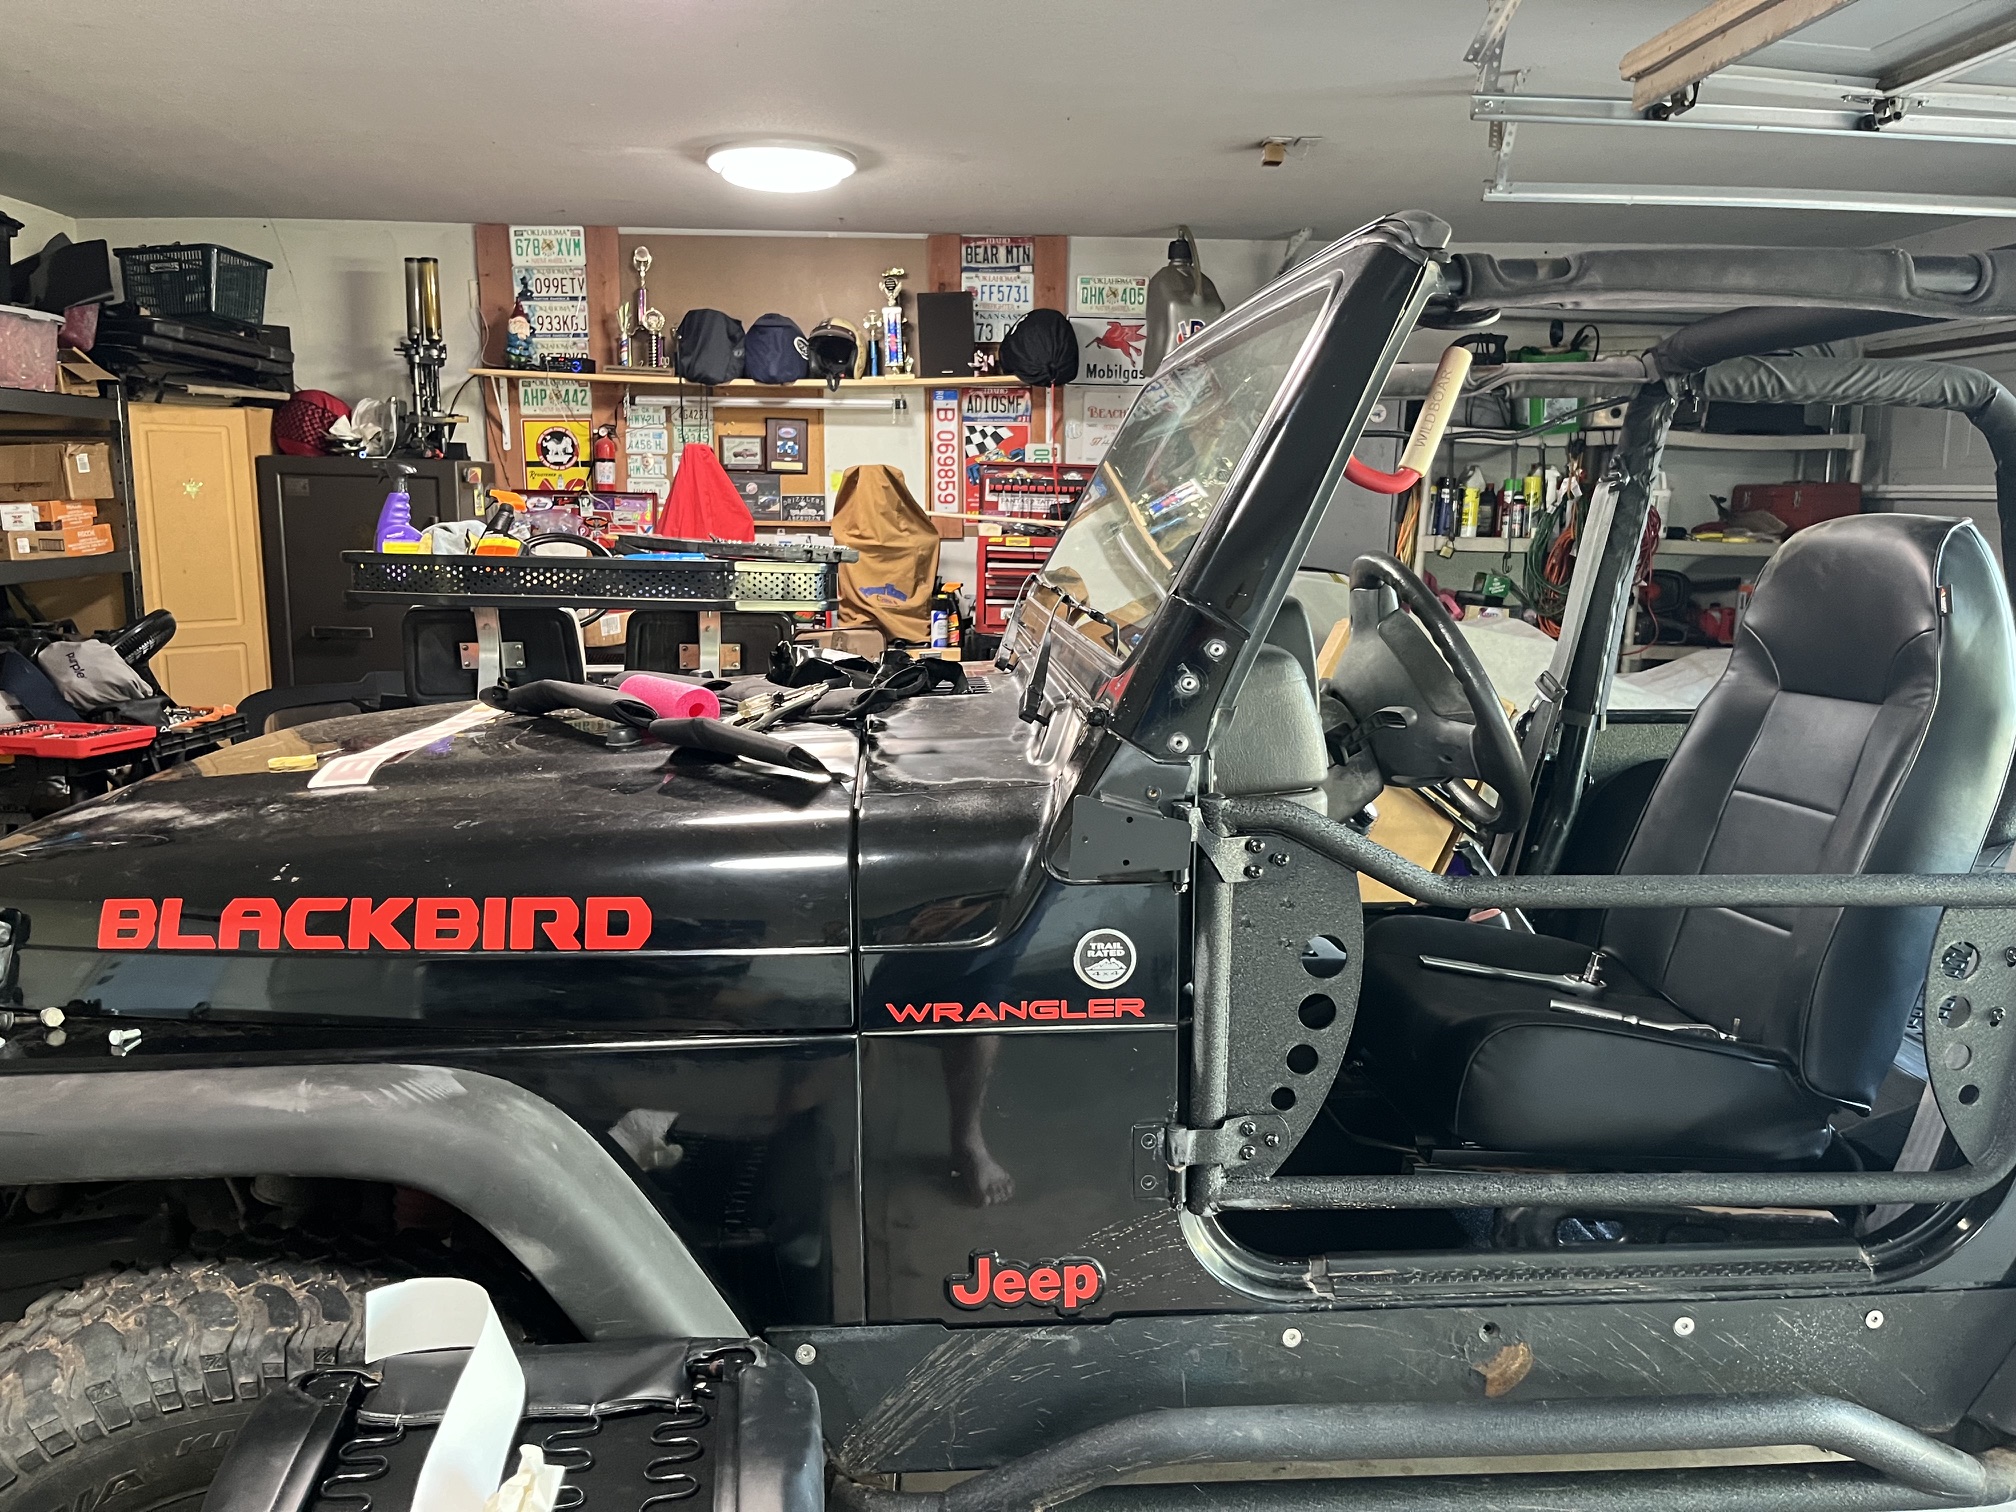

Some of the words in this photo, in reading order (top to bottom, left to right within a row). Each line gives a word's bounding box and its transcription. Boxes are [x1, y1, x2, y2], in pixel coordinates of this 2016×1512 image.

[515, 238, 540, 256] 678
[556, 238, 582, 256] XVM
[965, 245, 999, 264] BEAR
[1005, 245, 1031, 264] MTN
[1092, 277, 1133, 285] OKLAHOMA
[980, 285, 1029, 303] FF5731
[1120, 287, 1145, 305] 405
[979, 312, 1019, 320] KANSAS
[975, 322, 994, 341] 73
[1086, 363, 1146, 383] Mobilgas
[523, 388, 547, 406] AHP
[562, 388, 588, 406] 442
[935, 390, 944, 400] RO
[966, 395, 1024, 414] ADIOSMF
[936, 407, 956, 423] B
[1414, 413, 1436, 448] WILD
[1428, 367, 1453, 412] BOAR
[936, 430, 956, 505] 069859
[65, 651, 86, 679] purple
[97, 896, 653, 951] BLACKBIRD
[1089, 942, 1124, 950] TRAIL
[885, 997, 1146, 1023] WRANGLER
[952, 1256, 1099, 1308] Jeep
